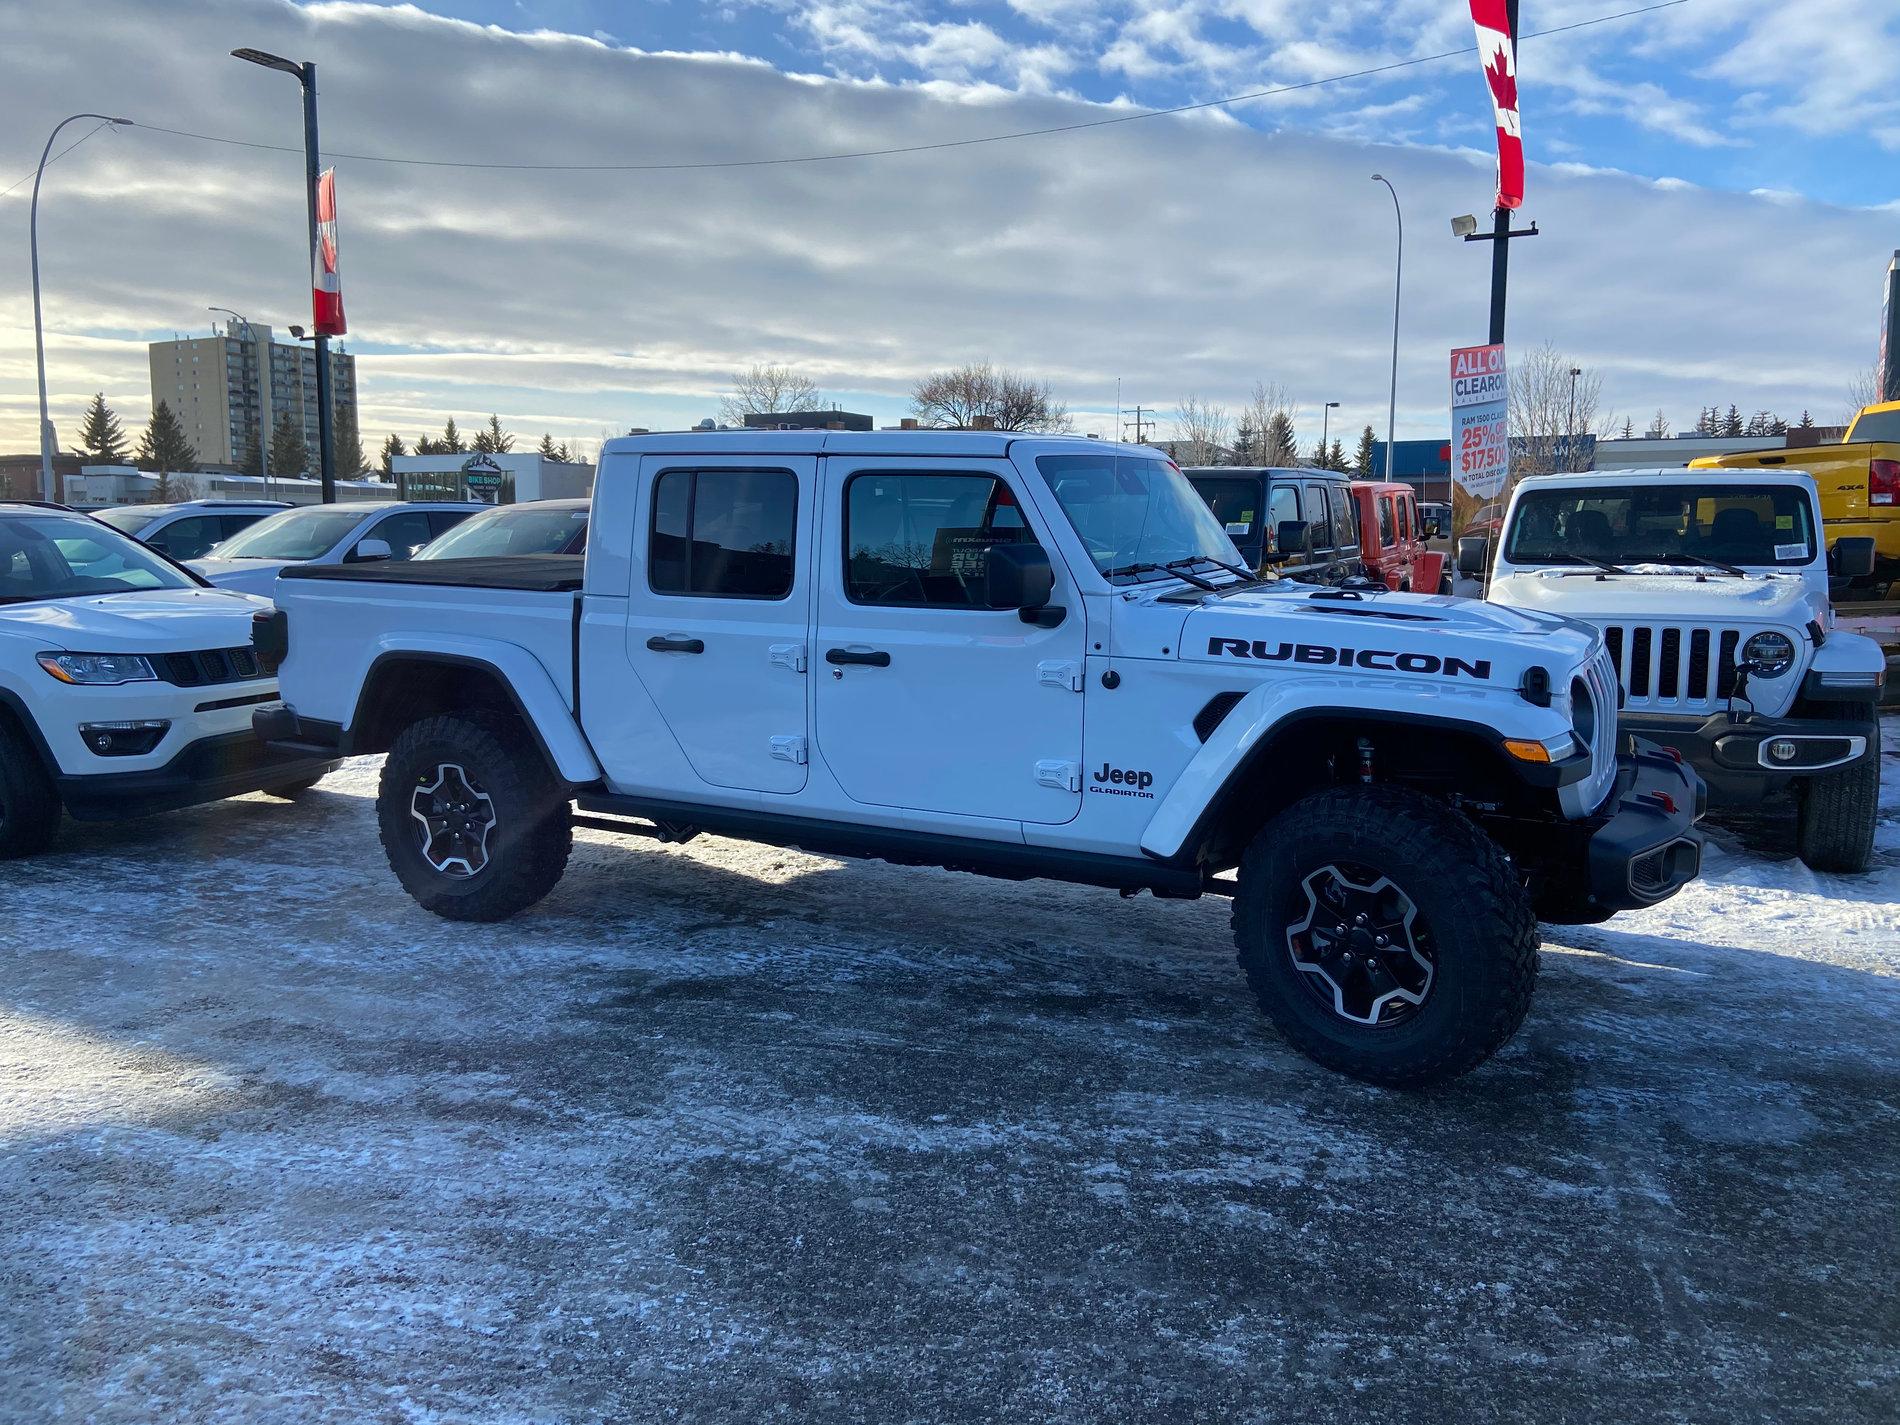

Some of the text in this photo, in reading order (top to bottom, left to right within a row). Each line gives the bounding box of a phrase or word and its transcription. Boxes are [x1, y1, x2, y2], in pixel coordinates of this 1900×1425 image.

[1455, 351, 1486, 376] ALL
[1462, 415, 1475, 426] RAM
[1477, 413, 1490, 424] 1500
[1462, 423, 1495, 449] 25%
[468, 476, 500, 485] BIKE SHOP
[1468, 472, 1485, 481] TOTAL
[1207, 637, 1491, 680] RUBICON
[1094, 763, 1153, 790] Jeep
[1089, 786, 1155, 799] GLADIATOR
